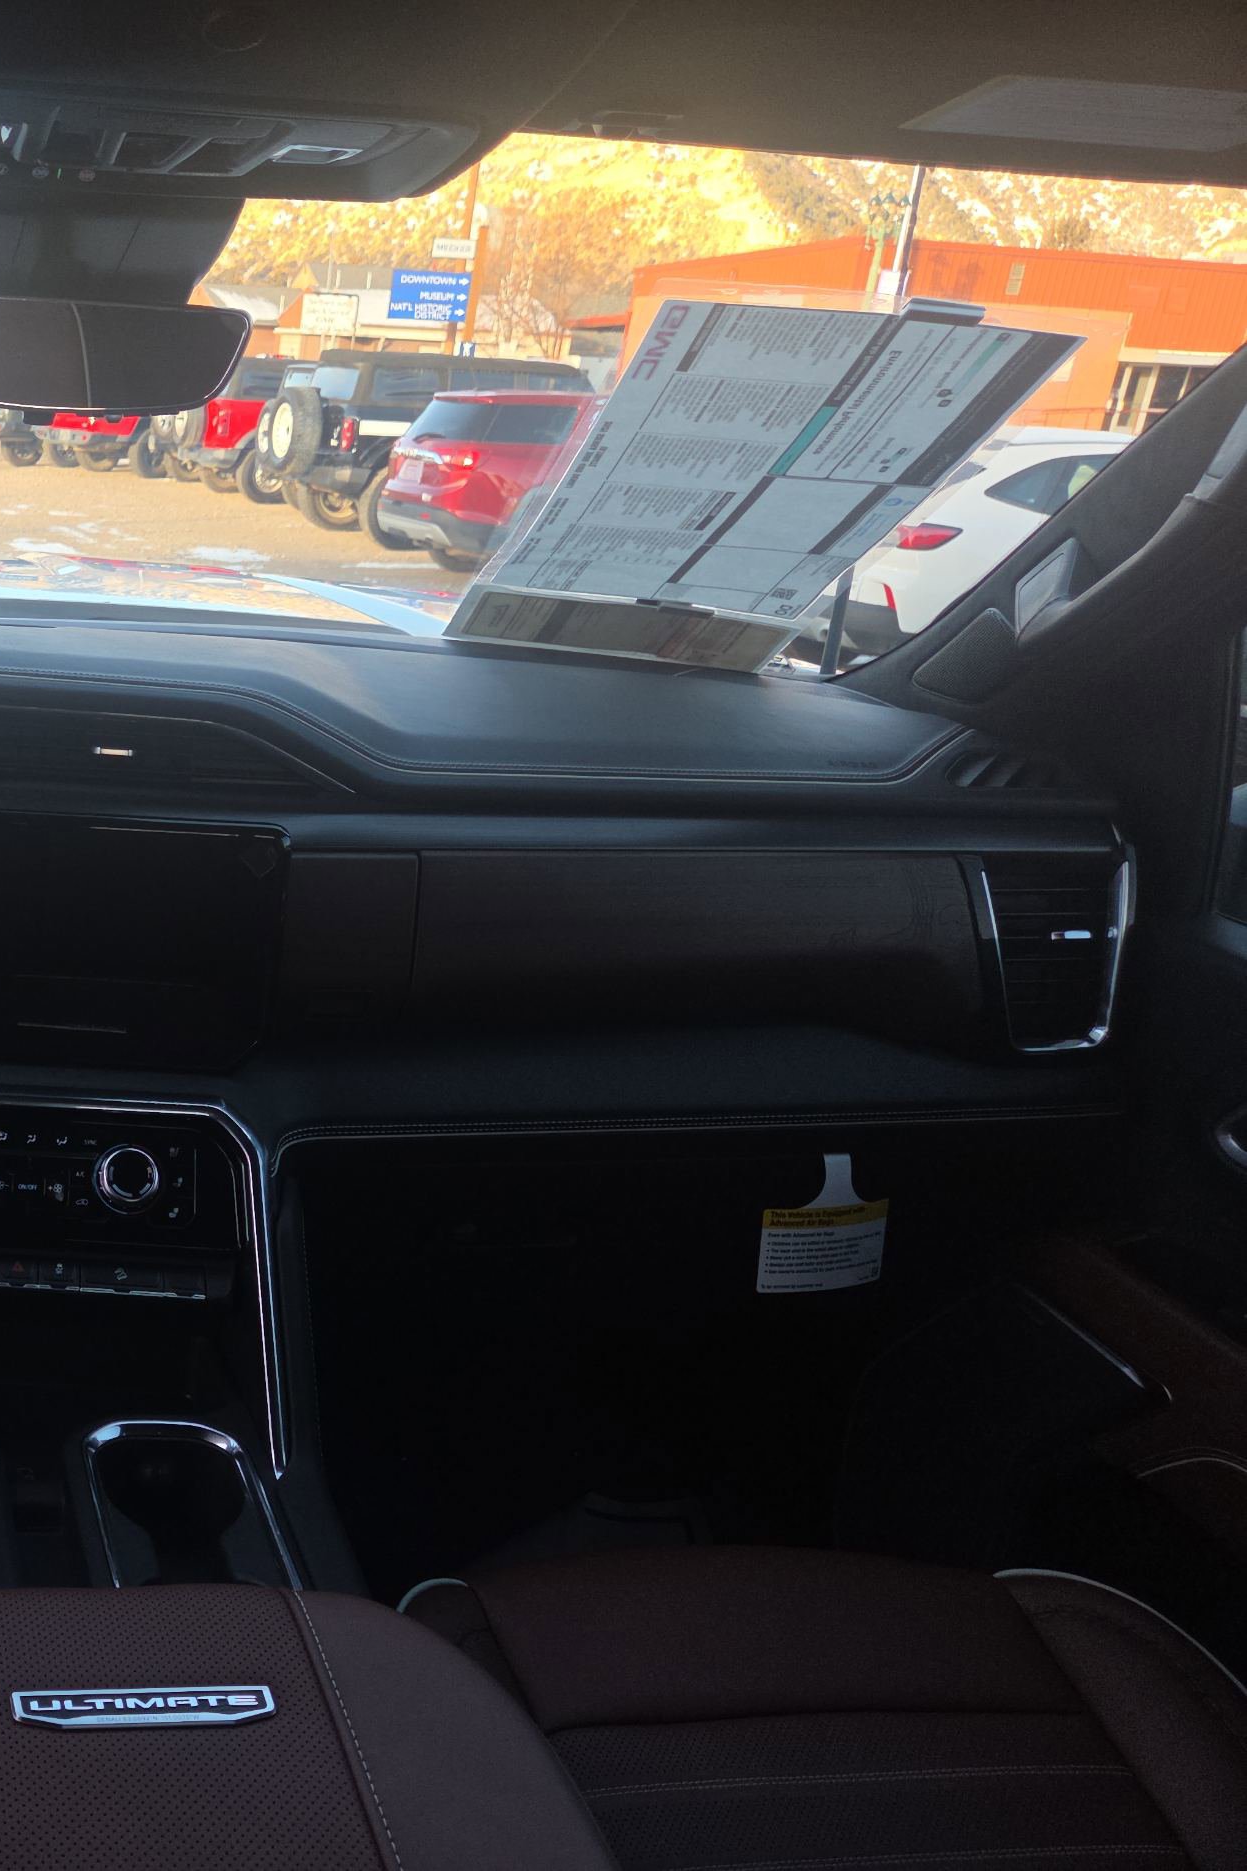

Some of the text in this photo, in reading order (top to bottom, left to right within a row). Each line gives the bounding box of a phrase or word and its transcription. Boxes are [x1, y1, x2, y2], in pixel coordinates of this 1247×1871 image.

[400, 275, 457, 286] DOWNTOWN
[419, 291, 455, 302] MUSEUM
[414, 303, 453, 313] HISTORIC
[17, 1183, 38, 1191] ON/OFF
[29, 1695, 260, 1712] ULTIMATE
